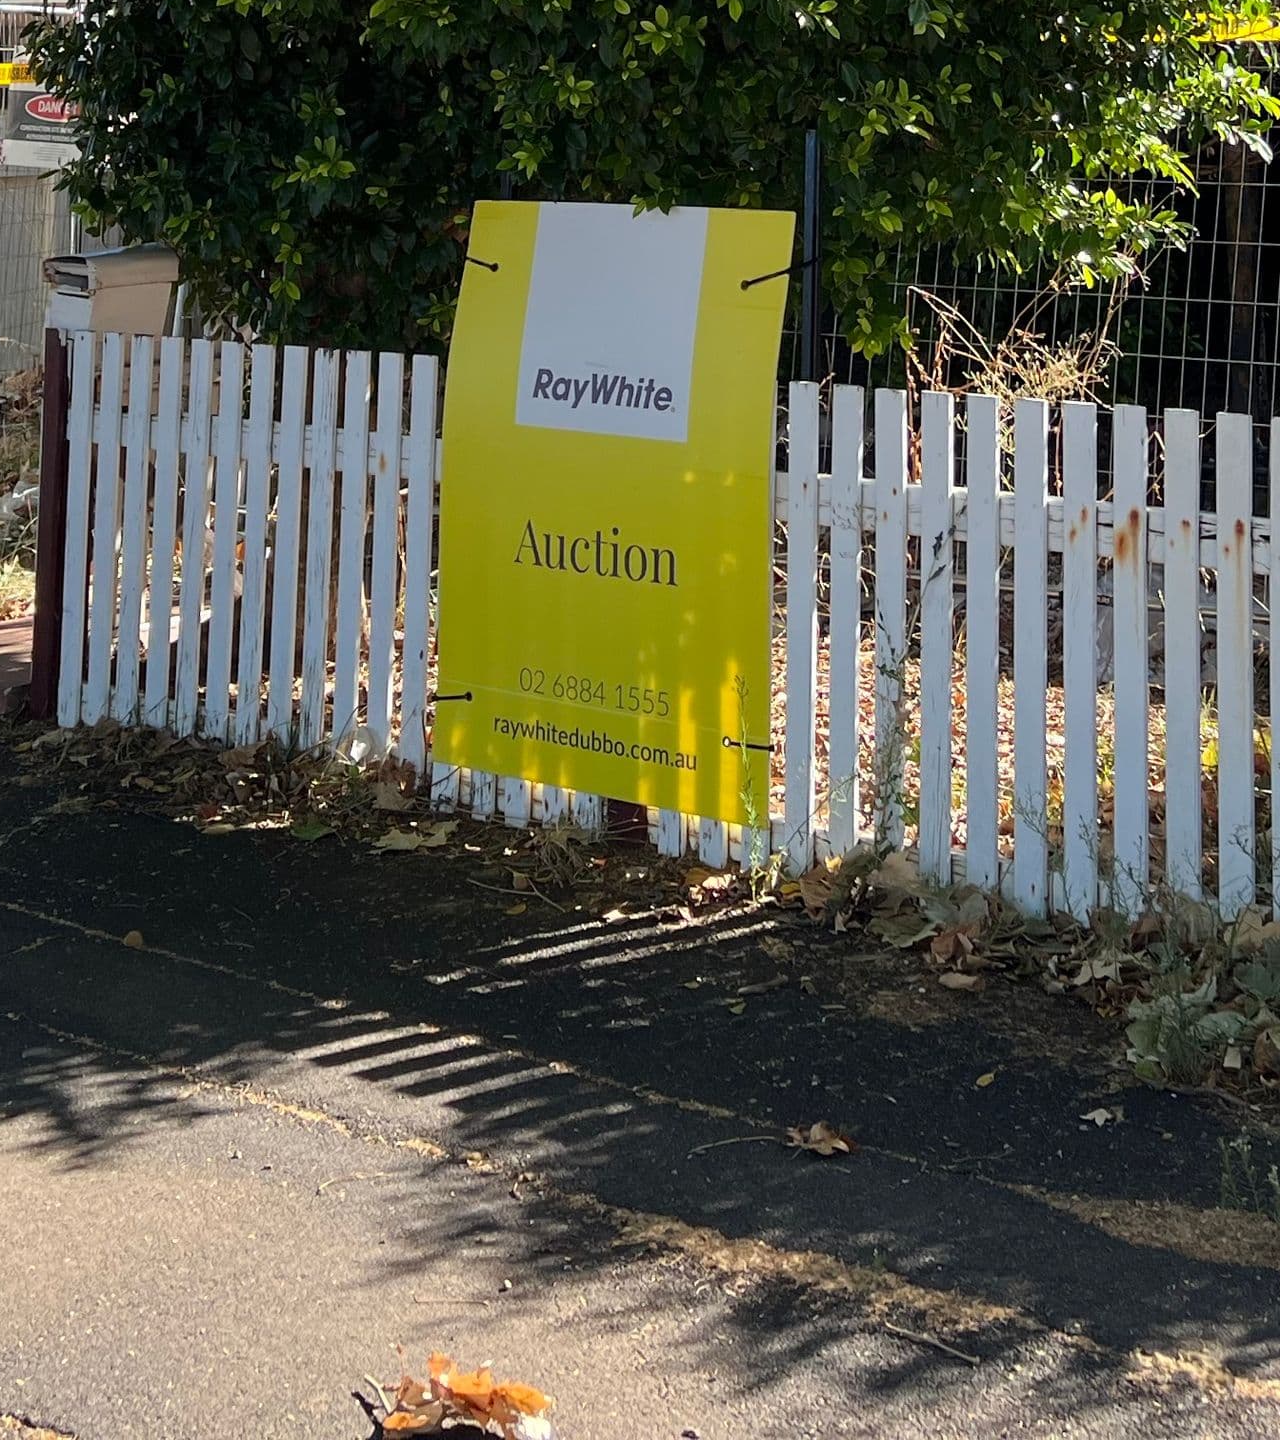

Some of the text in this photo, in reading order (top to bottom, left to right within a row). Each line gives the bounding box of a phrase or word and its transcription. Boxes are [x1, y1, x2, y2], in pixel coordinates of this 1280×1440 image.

[532, 367, 673, 412] RayWhite
[513, 518, 678, 587] Auction
[519, 667, 670, 717] 02 6884 1555
[493, 715, 698, 772] raywhitedubbo.com.au
